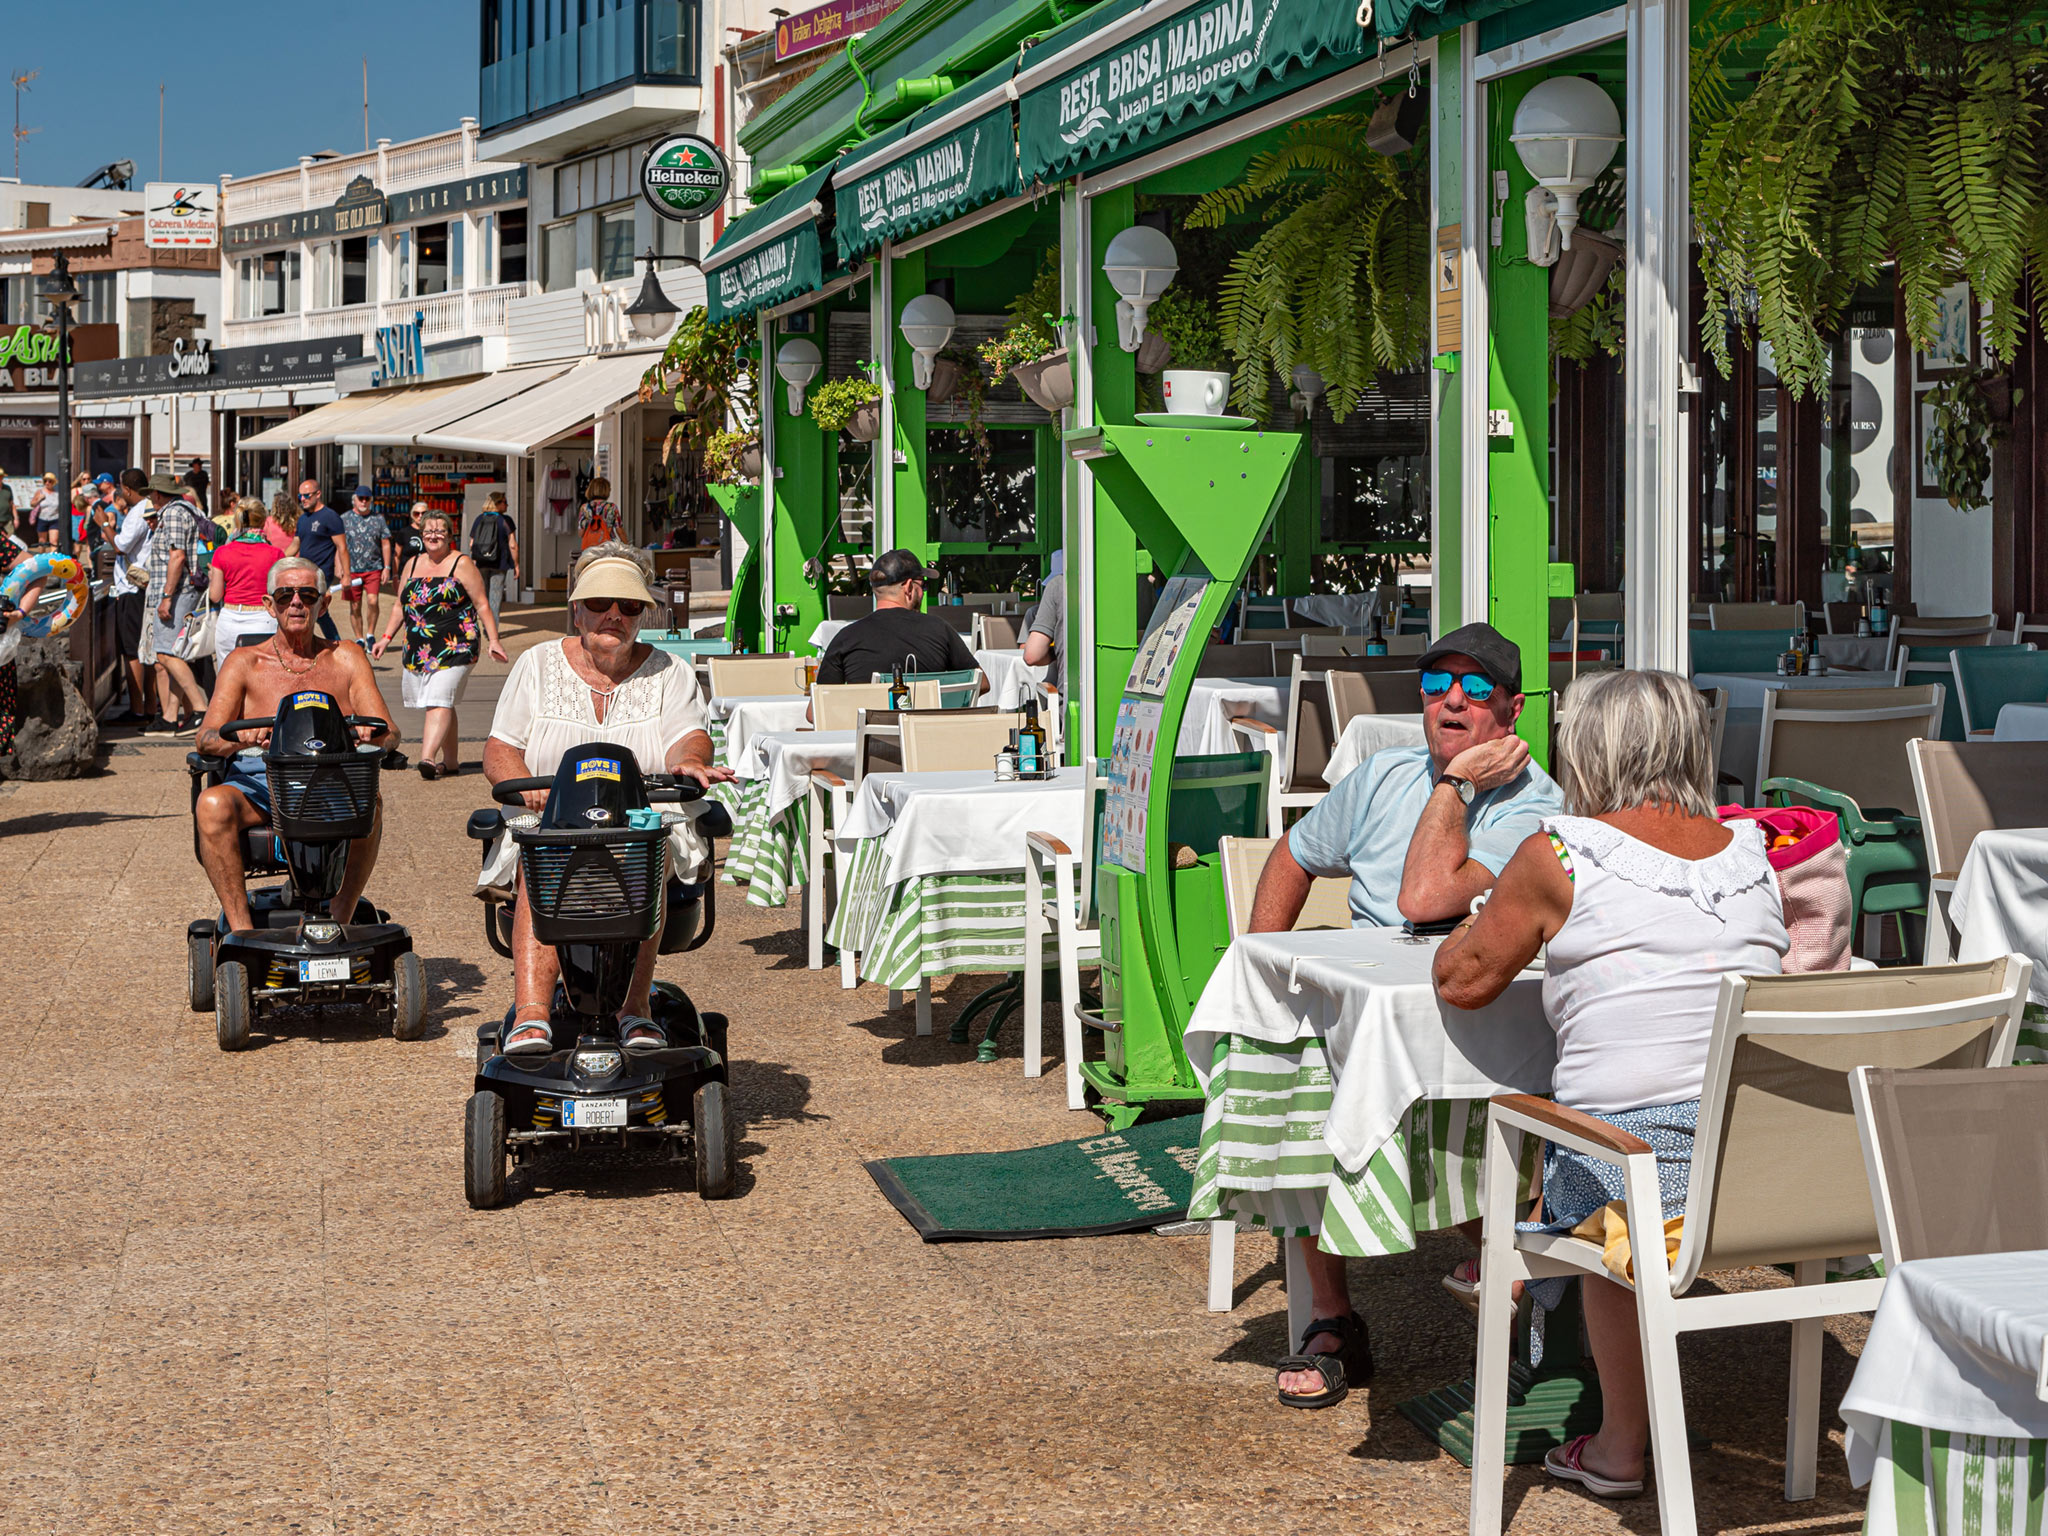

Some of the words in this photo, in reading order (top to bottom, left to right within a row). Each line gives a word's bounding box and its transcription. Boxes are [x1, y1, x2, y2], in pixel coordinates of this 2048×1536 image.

[1253, 9, 1274, 63] FUNDADO
[1059, 67, 1101, 126] REST.
[1108, 37, 1162, 101] BRISA
[1165, 0, 1254, 73] MARINA
[1116, 94, 1150, 124] Juan
[1152, 79, 1168, 107] El
[1171, 49, 1253, 97] Majorero
[650, 169, 720, 185] Heineken
[884, 166, 917, 205] BRISA
[915, 140, 964, 190] MARINA
[409, 190, 448, 212] LIVE
[466, 175, 521, 201] MUSIC
[912, 196, 920, 213] El
[921, 182, 964, 209] Majorero
[148, 218, 182, 229] Cabrera
[183, 219, 215, 229] Medina
[235, 222, 279, 244] IRISH
[292, 215, 319, 234] PUB
[336, 210, 349, 231] THE
[350, 207, 364, 228] OLD
[364, 203, 382, 226] MILL
[1852, 310, 1877, 323] LOCAL
[168, 337, 210, 378] Santos
[581, 760, 610, 769] ROYS
[317, 968, 338, 980] LEYNA
[585, 1110, 614, 1125] ROBERT
